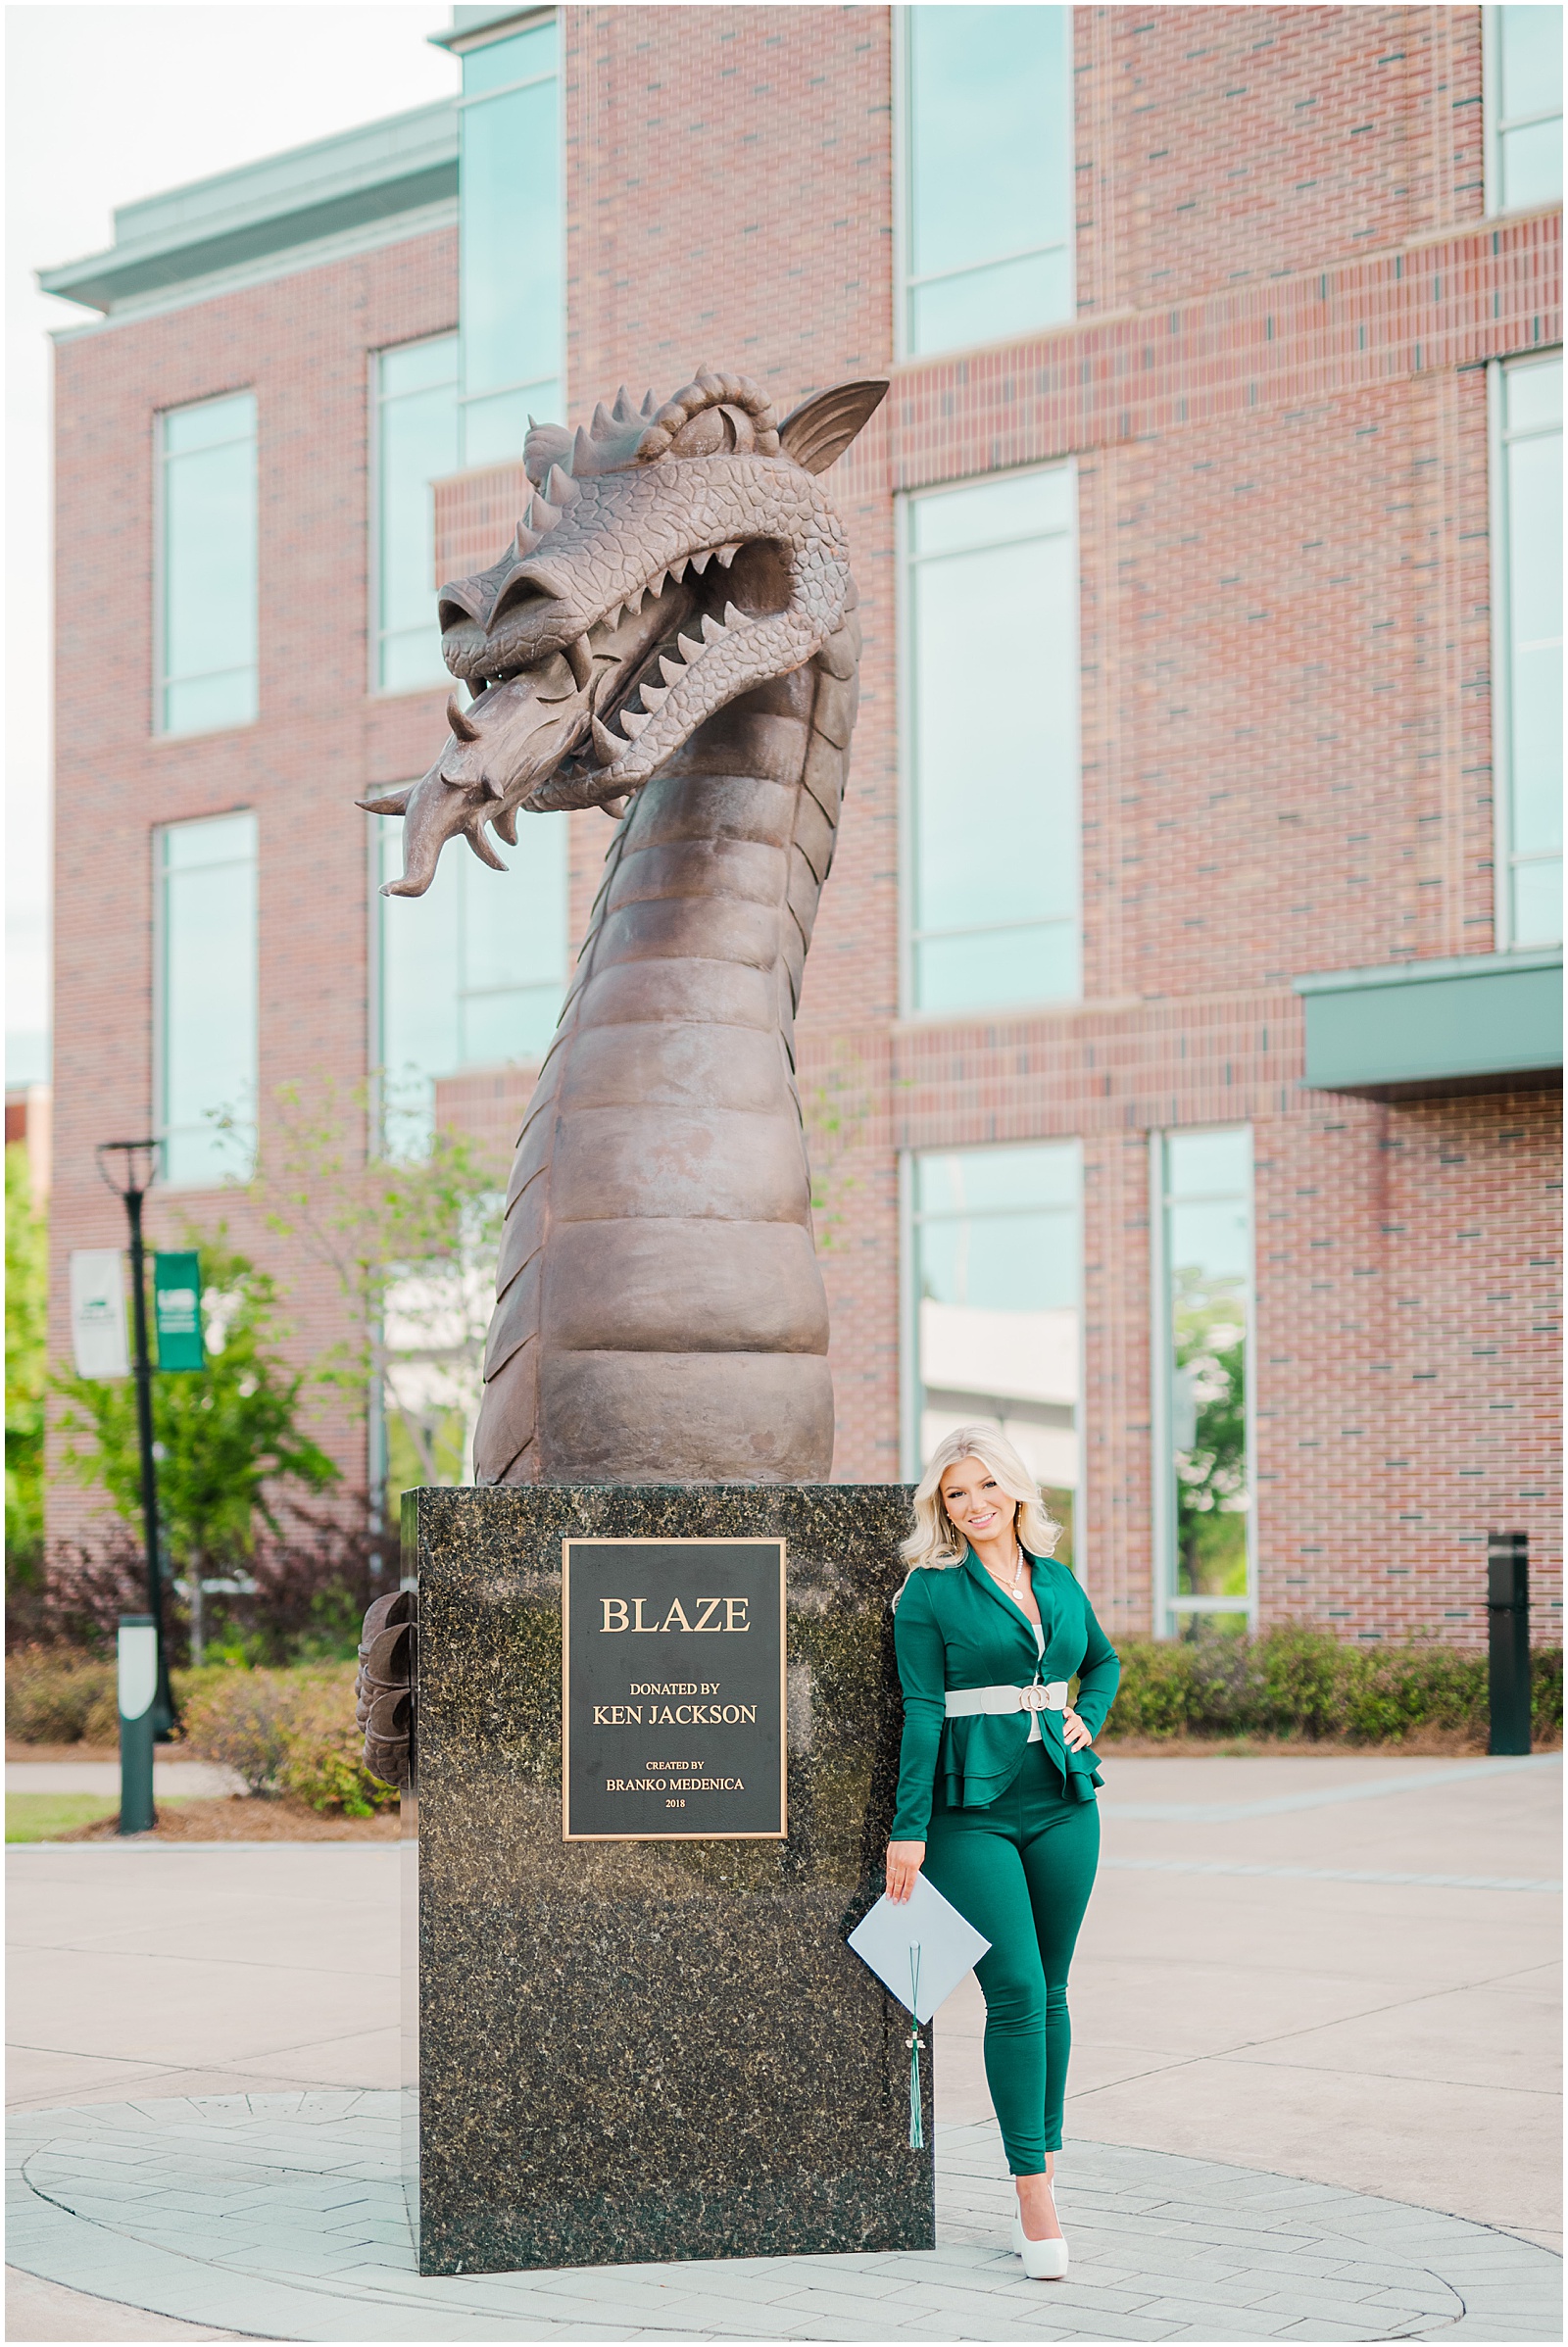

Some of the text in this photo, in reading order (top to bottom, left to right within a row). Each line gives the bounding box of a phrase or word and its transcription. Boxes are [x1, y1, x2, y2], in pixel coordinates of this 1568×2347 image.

[599, 1597, 752, 1634] BLAZE
[629, 1683, 721, 1695] DONATED BY
[592, 1704, 759, 1725] KEN JACKSON
[645, 1761, 705, 1771] CREATED BY
[606, 1778, 745, 1791] BRANKO MEDENICA
[664, 1798, 686, 1809] 2018
